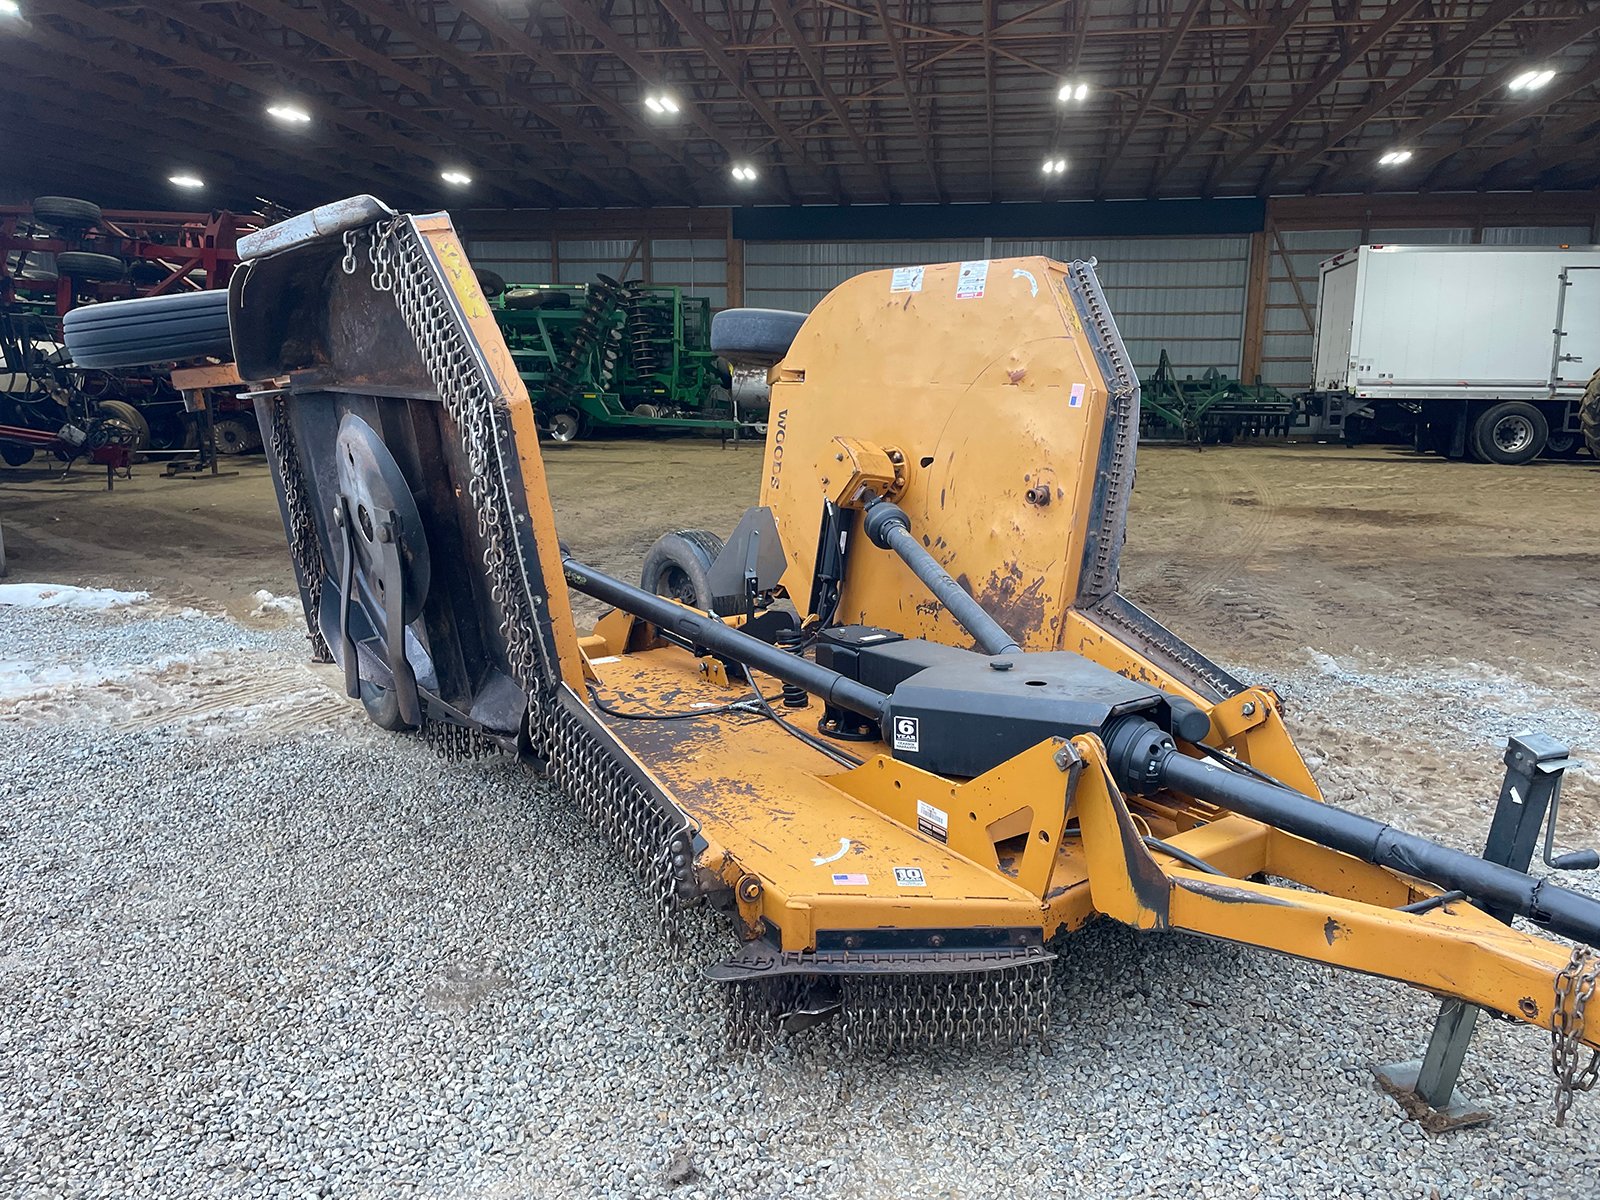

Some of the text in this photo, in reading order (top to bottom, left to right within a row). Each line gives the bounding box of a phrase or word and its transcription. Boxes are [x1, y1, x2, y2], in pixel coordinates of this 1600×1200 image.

[771, 409, 788, 489] WOODS
[898, 720, 915, 734] 6
[896, 870, 921, 878] 10
